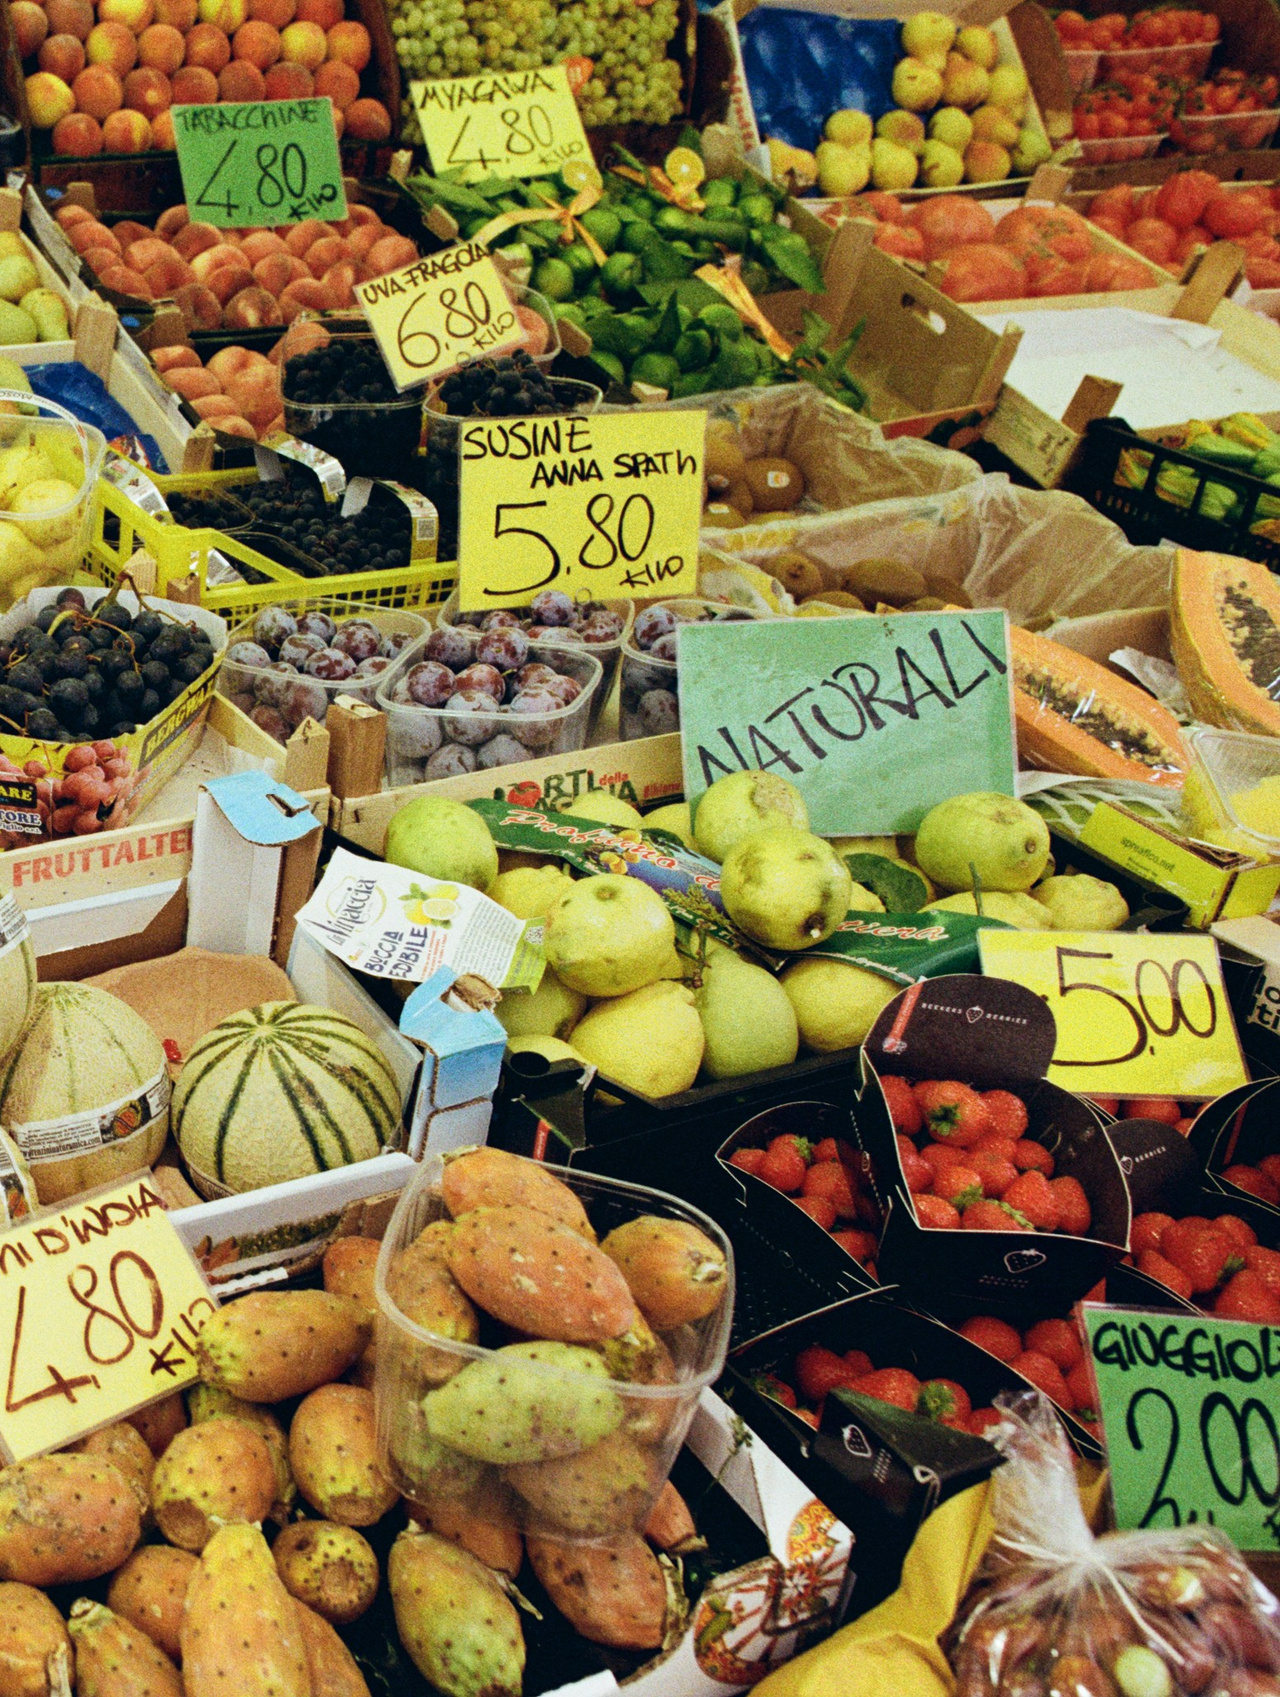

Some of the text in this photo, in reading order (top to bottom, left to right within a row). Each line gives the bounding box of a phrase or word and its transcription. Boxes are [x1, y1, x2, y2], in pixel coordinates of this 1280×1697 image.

[420, 72, 556, 111] MYAGAWA
[362, 243, 491, 305] UVA FRAGOLA
[472, 311, 515, 350] KILO
[463, 416, 593, 460] SUSINE
[529, 457, 604, 489] ANNA
[619, 555, 684, 589] KILO
[696, 619, 1008, 788] NATURALI
[499, 808, 679, 871] Profumo
[363, 929, 405, 973] BUCCIA
[387, 926, 429, 979] EDIBILE
[1093, 1321, 1280, 1384] GIUGGIOL
